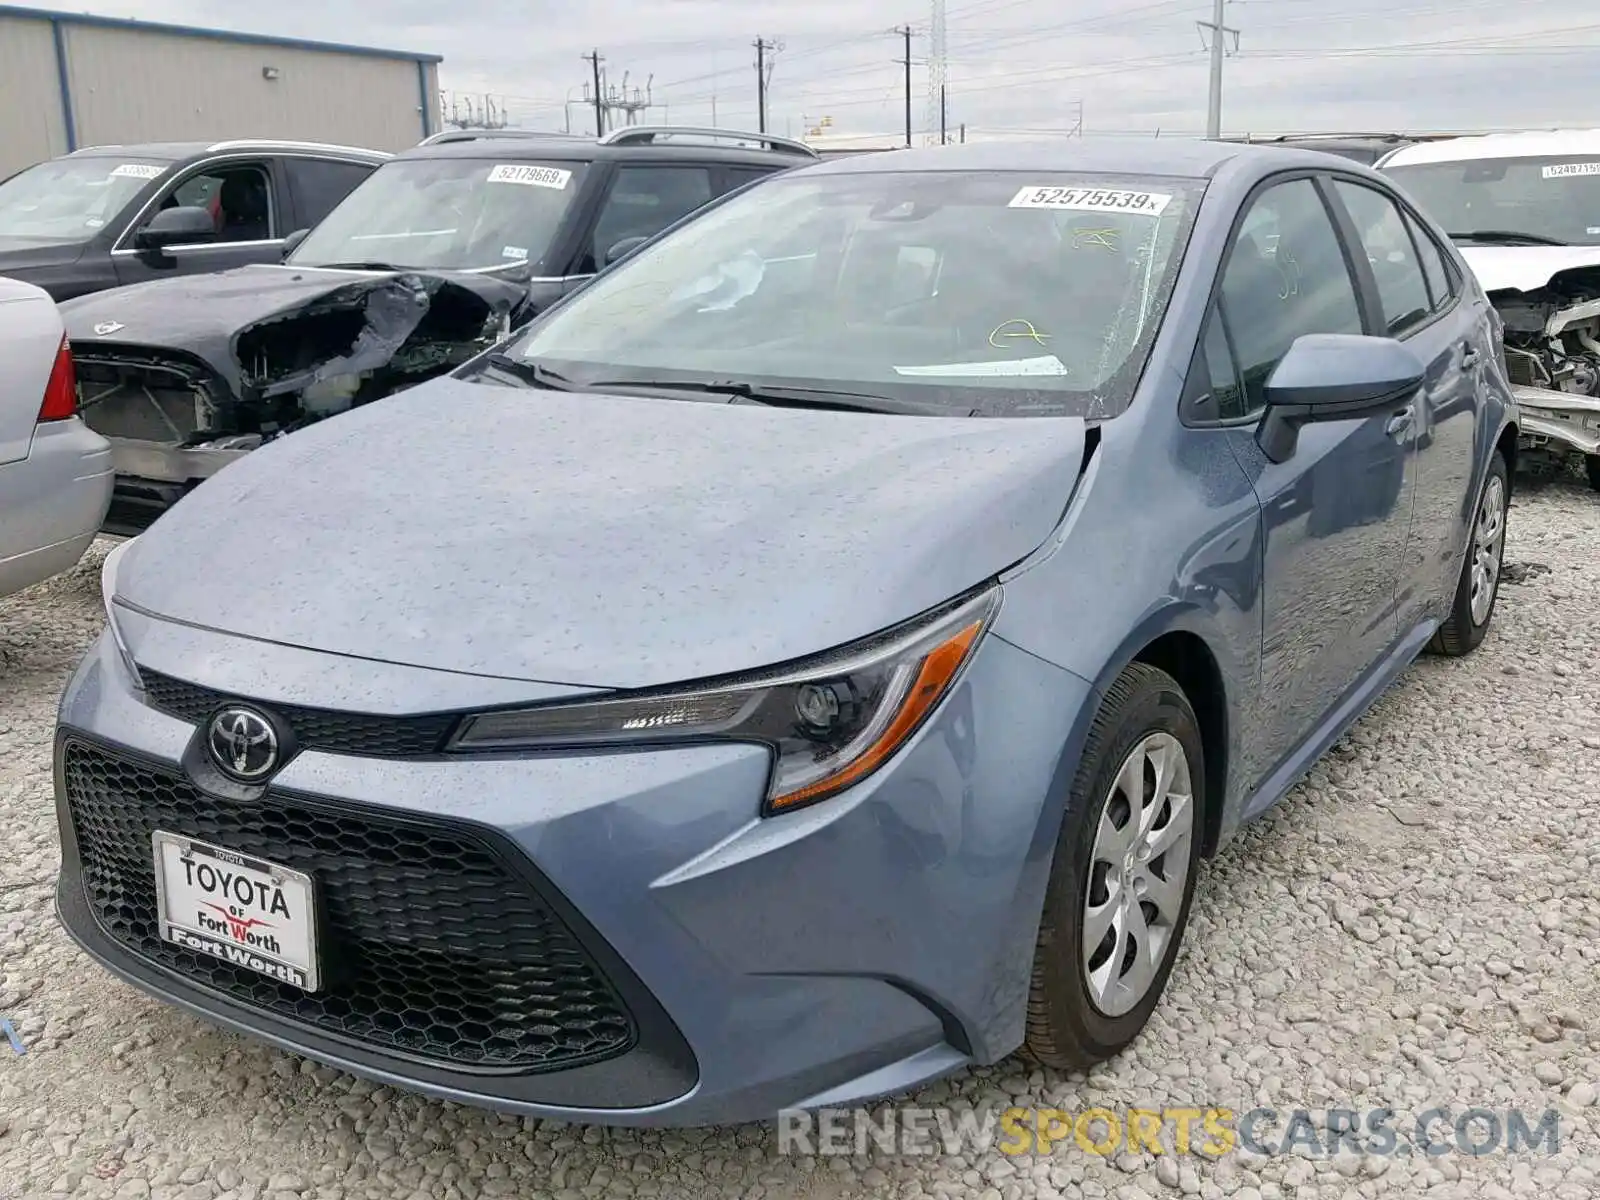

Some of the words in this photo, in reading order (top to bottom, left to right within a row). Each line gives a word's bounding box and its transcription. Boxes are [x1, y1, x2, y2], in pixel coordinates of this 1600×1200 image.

[214, 850, 245, 866] TOYOTA
[180, 857, 291, 920] TOYOTA
[171, 929, 224, 955] Fort
[225, 946, 303, 986] Worth
[197, 911, 229, 936] Fort
[230, 923, 281, 954] Worth
